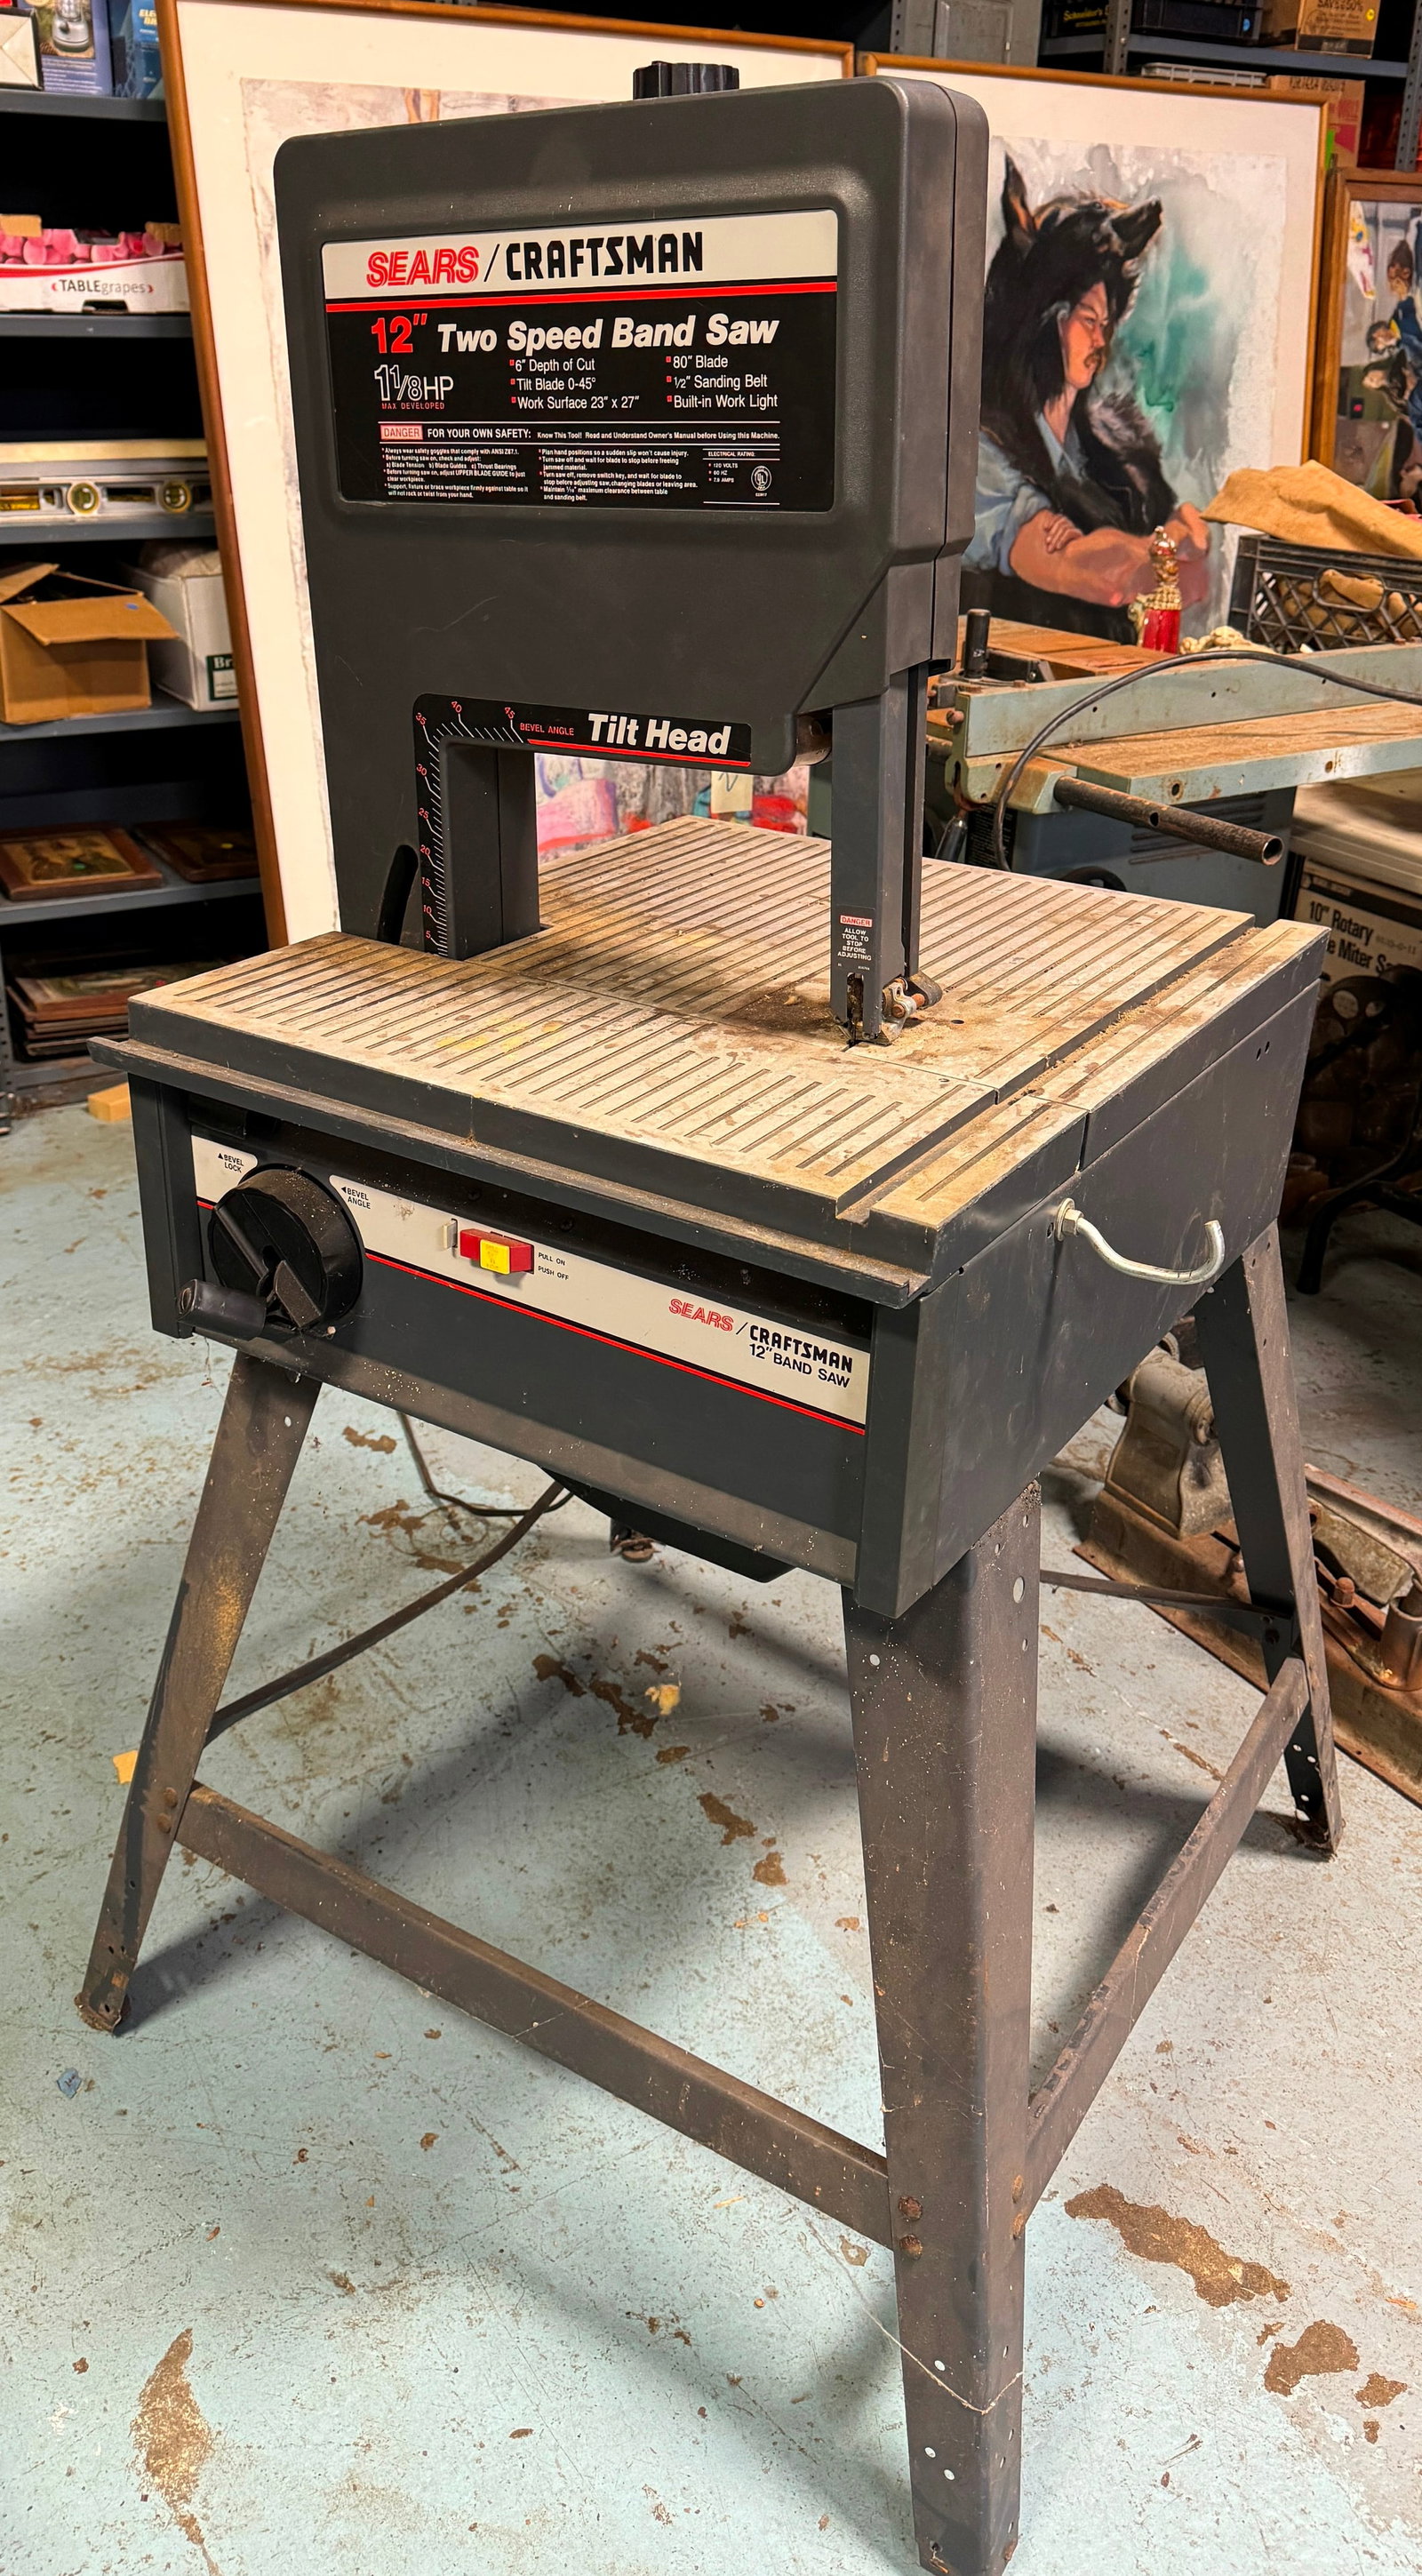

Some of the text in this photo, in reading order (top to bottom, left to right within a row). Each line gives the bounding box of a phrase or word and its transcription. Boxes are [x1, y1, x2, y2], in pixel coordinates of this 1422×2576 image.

[366, 245, 480, 287] SEARS
[506, 231, 703, 280] CRAFTSMAN
[59, 279, 146, 295] TABLEgrapes
[371, 313, 779, 356] 12" Two Speed Band Saw
[515, 357, 595, 374] 6" Depth of Cut
[673, 355, 729, 368] 80" Blade
[516, 377, 596, 391] Tilt Blade 0-45°
[694, 374, 740, 390] Sanding
[745, 374, 768, 388] Belt
[401, 402, 444, 410] DEVELOPED
[518, 395, 639, 410] Work Surface 23" x 27"
[674, 394, 778, 411] Built-in Work Light
[384, 428, 419, 437] DANGER
[427, 428, 444, 438] FOR
[447, 428, 470, 438] YOUR
[473, 428, 492, 438] OWN
[496, 428, 531, 438] SAFETY:
[718, 432, 736, 440] Using
[569, 449, 593, 457] positions
[671, 450, 689, 458] injury.
[662, 481, 683, 489] leaving
[451, 700, 462, 713] 40
[504, 707, 515, 719] 45
[415, 712, 427, 725] 35
[520, 722, 575, 737] BEVEL ANGLE
[588, 713, 731, 755] Tilt Head
[416, 764, 427, 776] 30
[418, 807, 428, 820] 25
[419, 844, 431, 856] 20
[421, 876, 431, 887] 15
[423, 904, 432, 915] 10
[842, 916, 870, 926] DANGER
[426, 930, 431, 939] 5
[1333, 909, 1374, 947] Rotary
[837, 951, 872, 961] ADJUSTING
[843, 946, 867, 954] BEFORE
[1338, 939, 1373, 969] Miter
[223, 1154, 244, 1166] BEVEL
[224, 1162, 242, 1173] LOCK
[347, 1188, 370, 1201] BEVEL
[348, 1196, 371, 1210] ANGLE
[538, 1252, 565, 1266] PULL ON
[538, 1266, 569, 1281] PUSH OFF
[668, 1298, 734, 1332] SEARS
[749, 1324, 853, 1373] CRAFTSMAN
[749, 1343, 851, 1388] 12" BAND SAW
